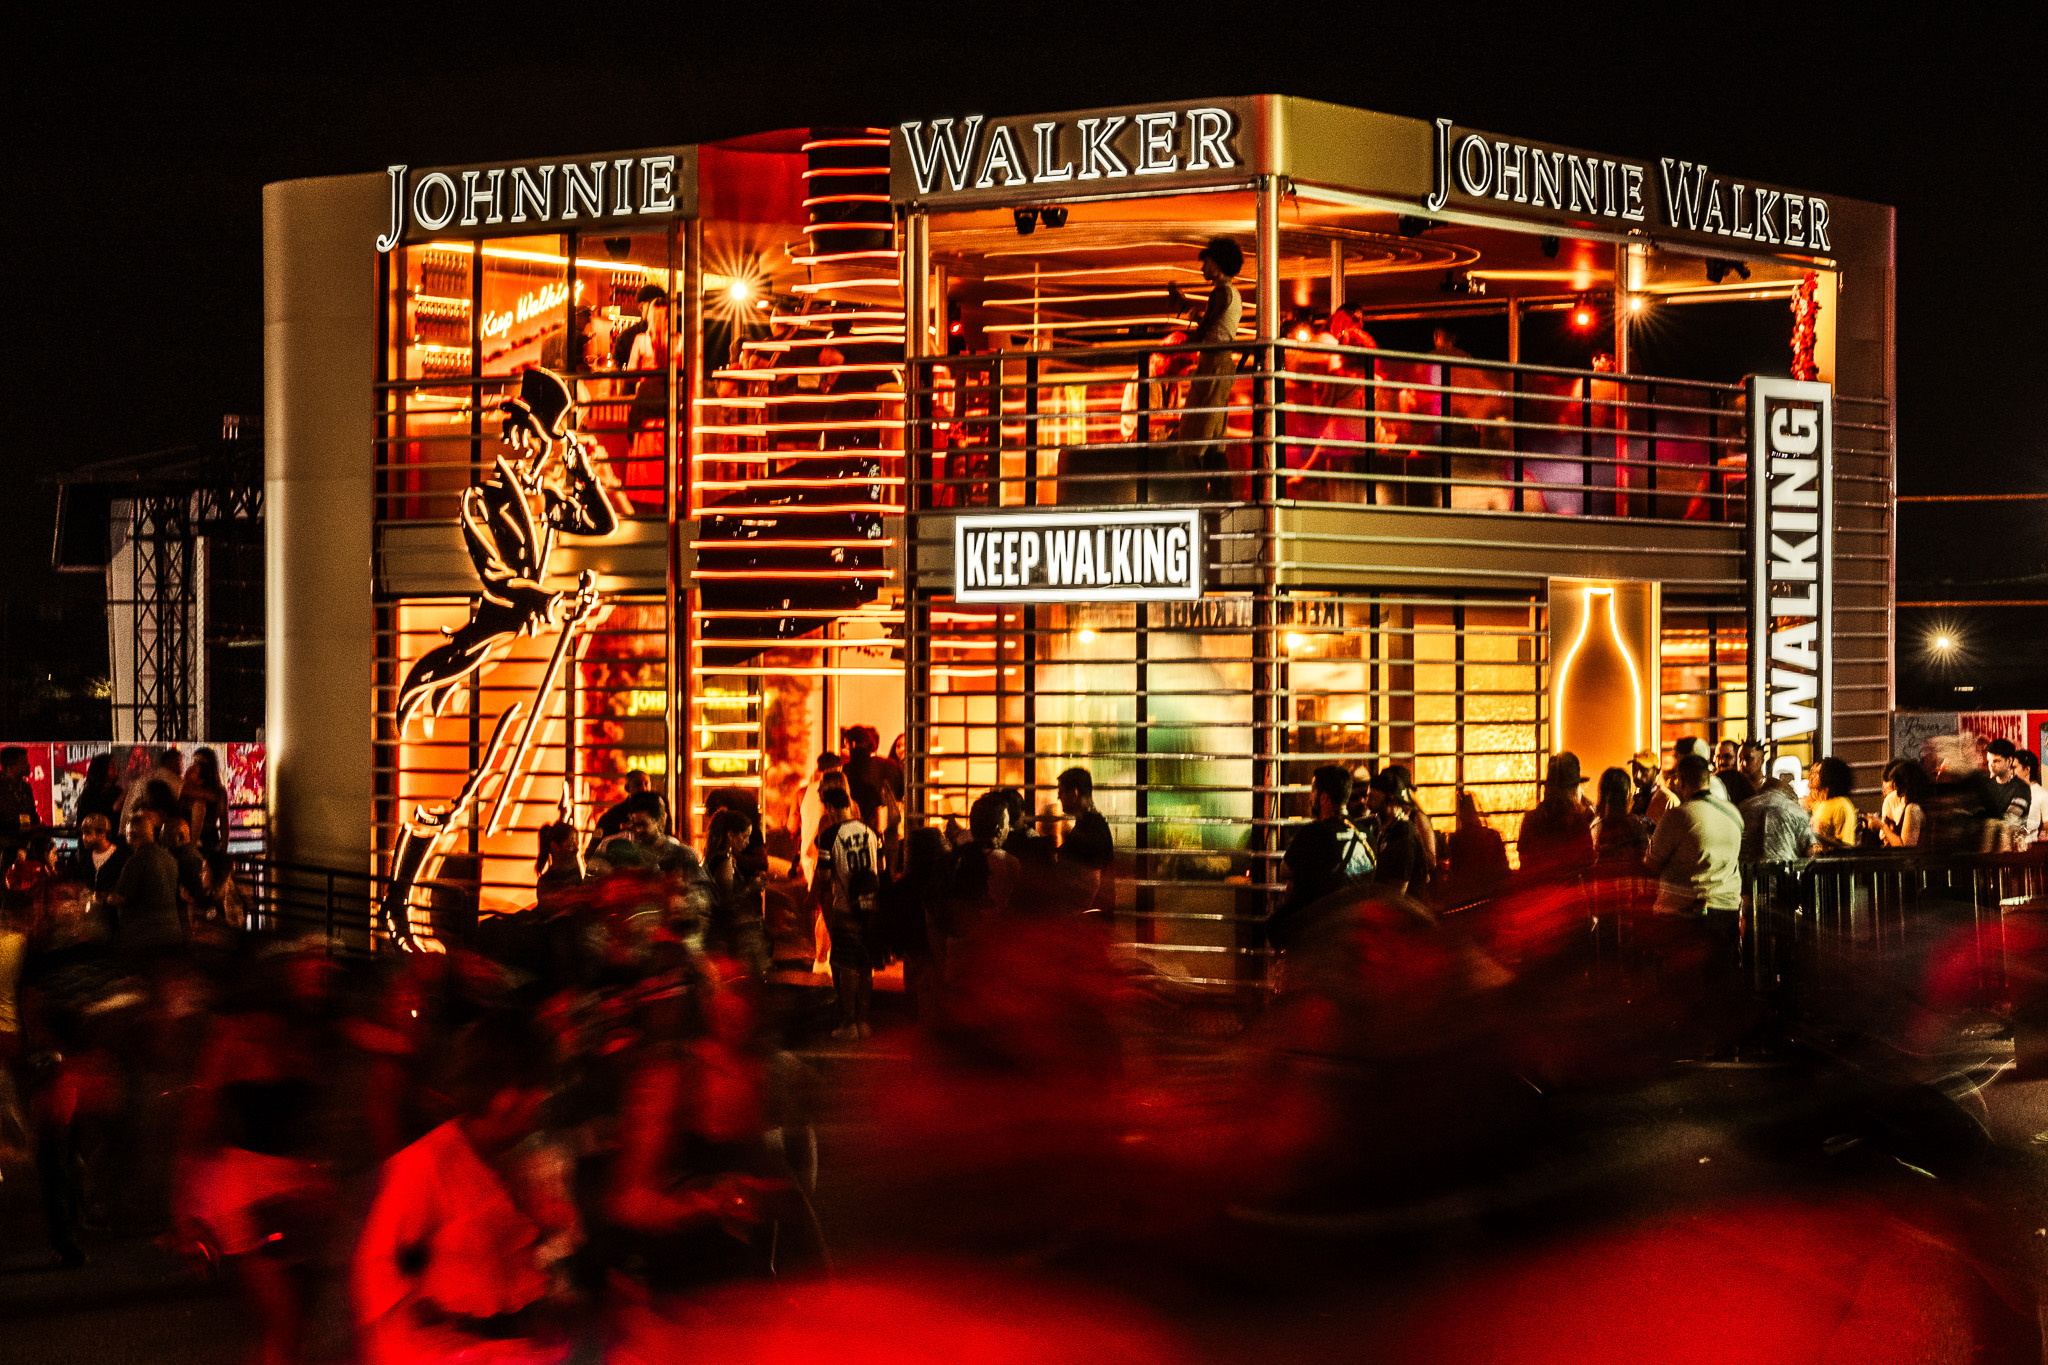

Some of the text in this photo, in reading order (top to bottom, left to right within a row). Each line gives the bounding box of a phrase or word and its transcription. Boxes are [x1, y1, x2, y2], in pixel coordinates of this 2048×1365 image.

[375, 107, 1237, 252] JOHNNIE WALKER
[1428, 118, 1832, 251] JOHNNIE WALKER
[481, 310, 513, 341] Keep
[966, 527, 1188, 587] KEEP WALKING
[1771, 407, 1818, 742] WALKING
